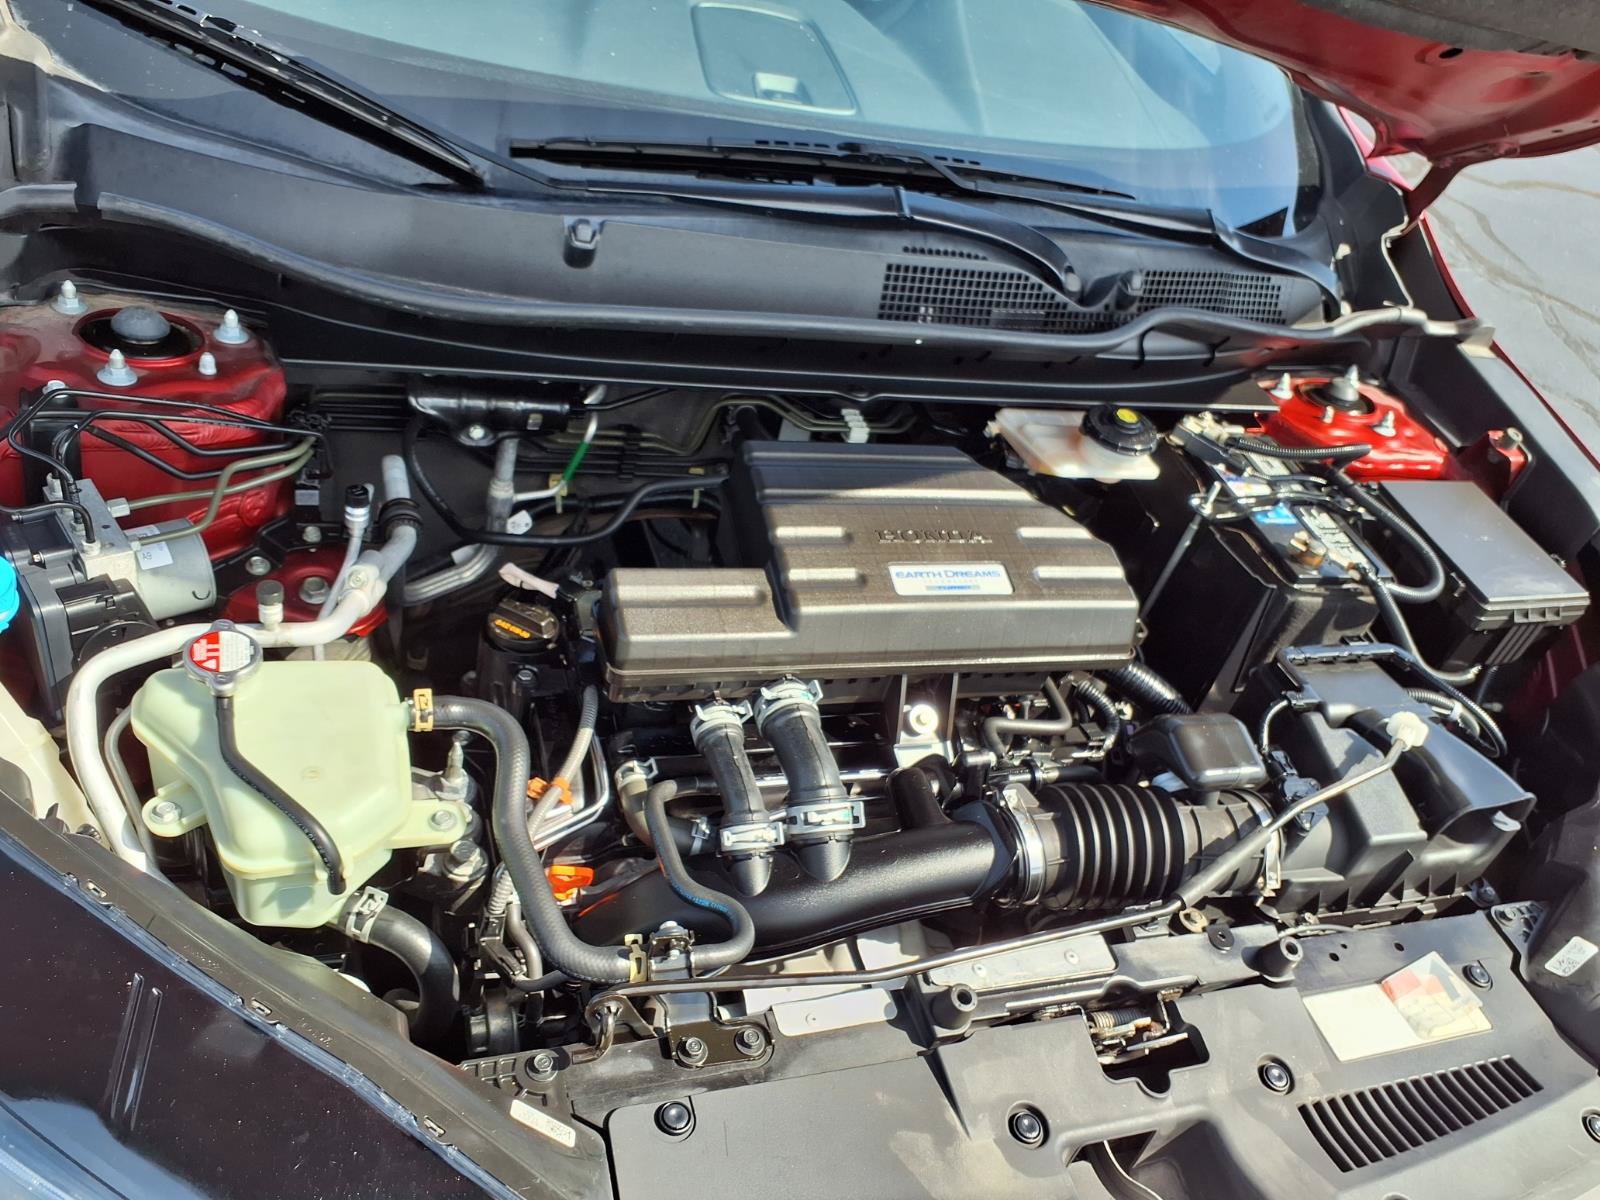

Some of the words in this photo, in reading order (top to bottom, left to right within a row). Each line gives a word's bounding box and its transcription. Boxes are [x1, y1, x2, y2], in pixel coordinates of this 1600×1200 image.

[875, 529, 993, 544] HONDA
[895, 570, 942, 579] EARTH
[944, 569, 1001, 579] DREAMS
